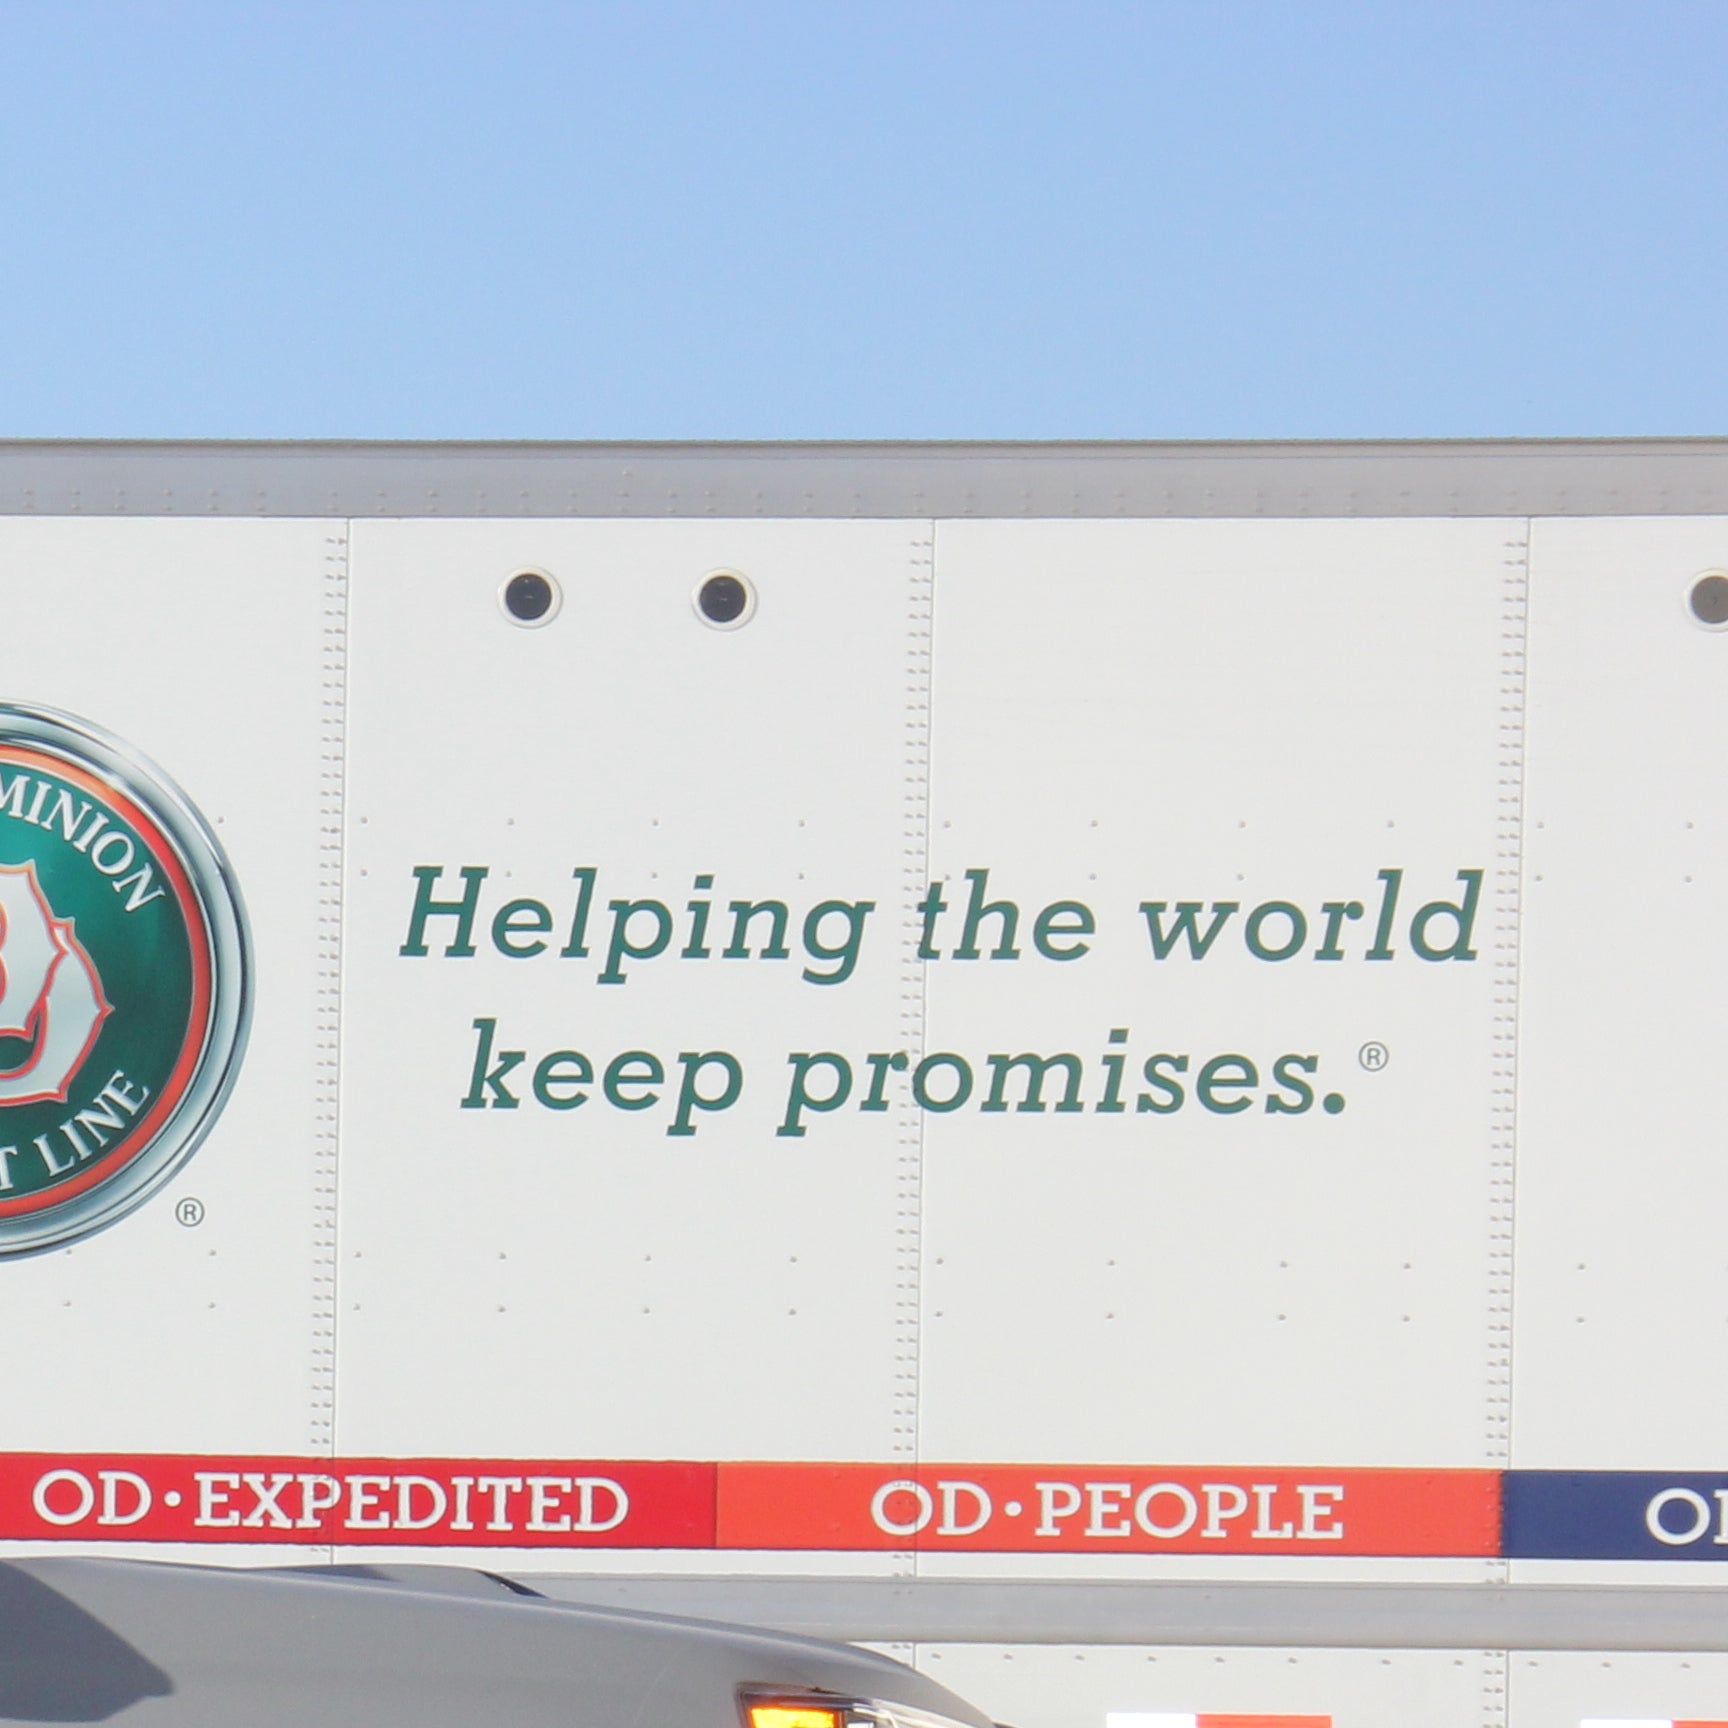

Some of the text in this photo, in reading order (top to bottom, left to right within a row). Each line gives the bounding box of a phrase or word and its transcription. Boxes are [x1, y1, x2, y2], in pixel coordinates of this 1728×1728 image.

[399, 865, 1483, 986] Helping the world
[32, 1069, 151, 1178] LINE
[459, 1018, 1345, 1138] keep promises.
